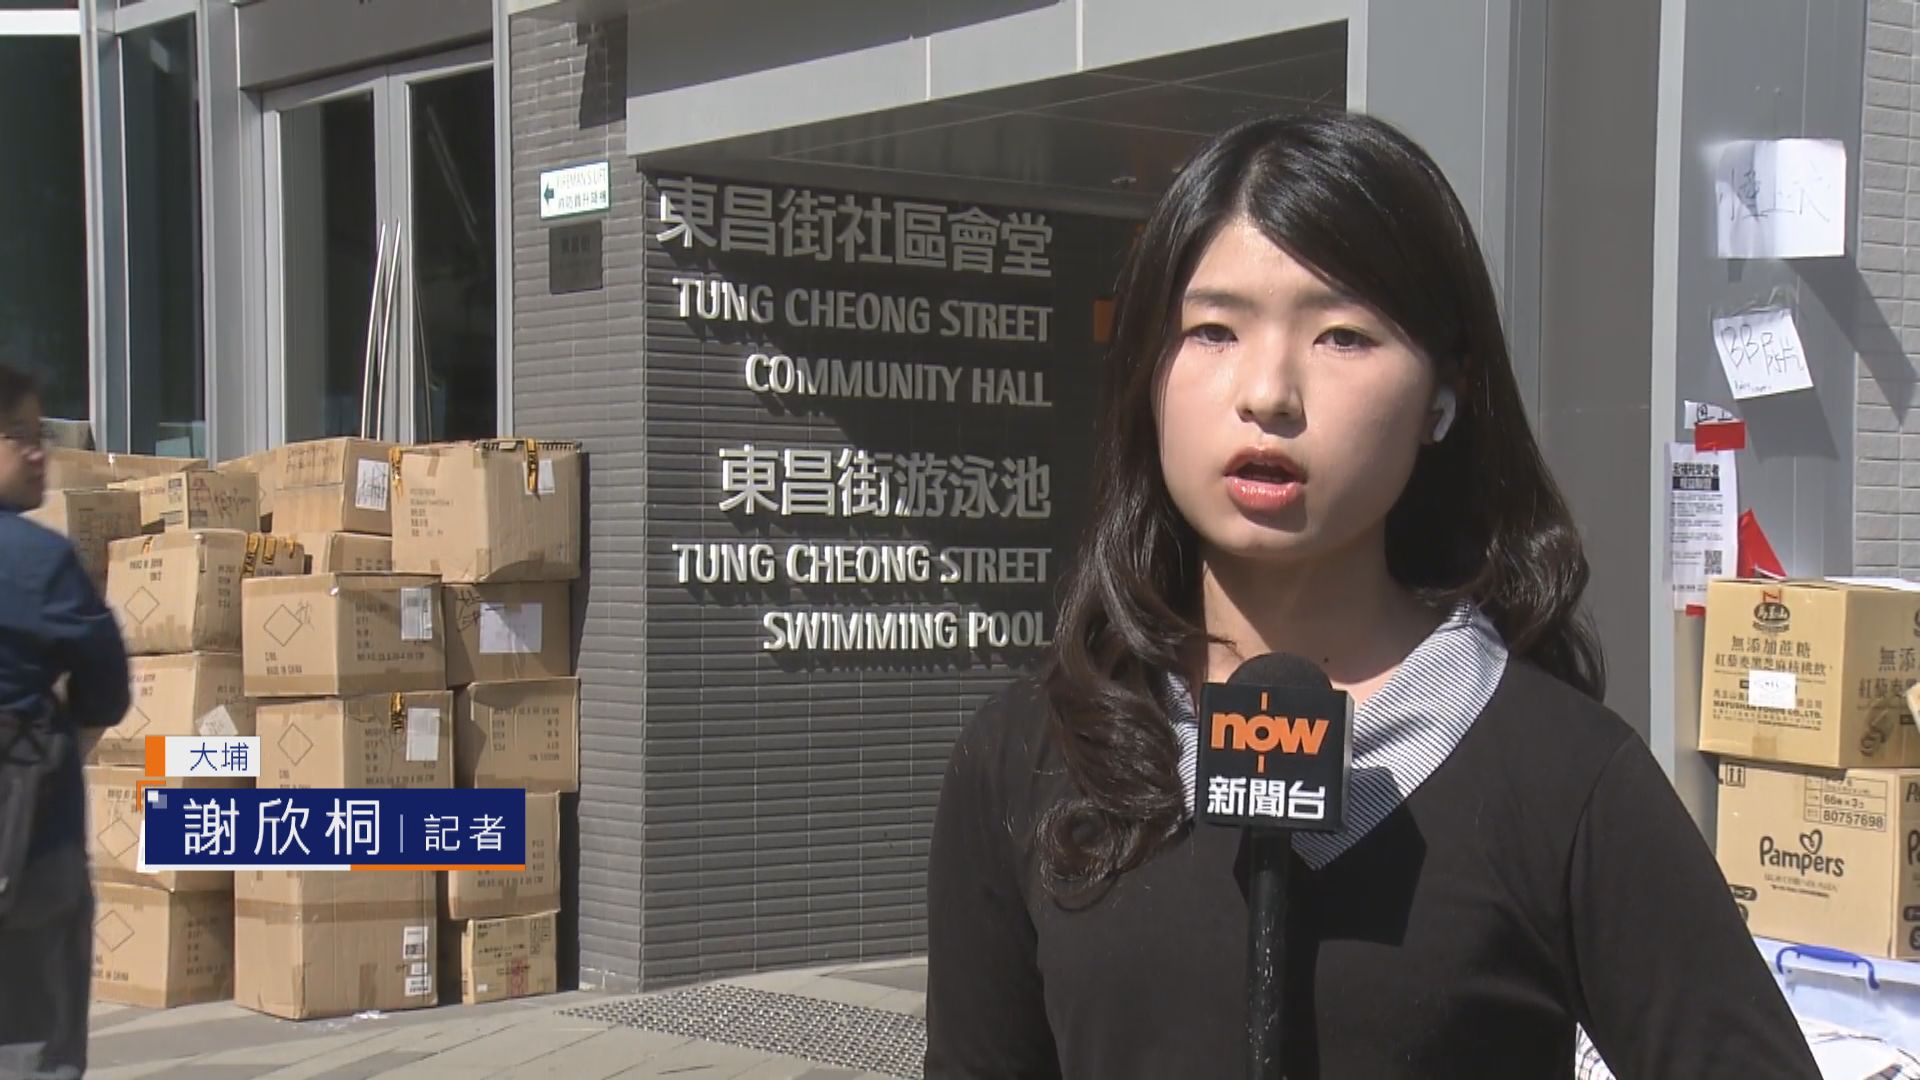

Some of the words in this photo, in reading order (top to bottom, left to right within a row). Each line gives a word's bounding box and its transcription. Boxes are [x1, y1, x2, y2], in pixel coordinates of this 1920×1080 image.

[656, 176, 1053, 278] 東昌街社區會堂
[672, 277, 774, 324] TUNG
[785, 287, 930, 334] CHEONG
[940, 300, 1053, 342] STREET
[745, 353, 963, 403] COMMUNITY
[972, 367, 1053, 407] HALL
[718, 444, 1051, 520] 東昌街游泳池
[672, 543, 775, 583] TUNG
[786, 544, 930, 583] CHEONG
[940, 546, 1052, 584] STREET
[763, 611, 958, 651] SWIMMING
[968, 611, 1052, 648] POOL
[1731, 635, 1811, 658] 無添加蔗糖
[1878, 645, 1920, 672] 無添
[1210, 712, 1329, 755] now
[1207, 774, 1326, 820] 新聞台
[1823, 810, 1884, 828] 80757698
[1759, 835, 1845, 878] Pampers
